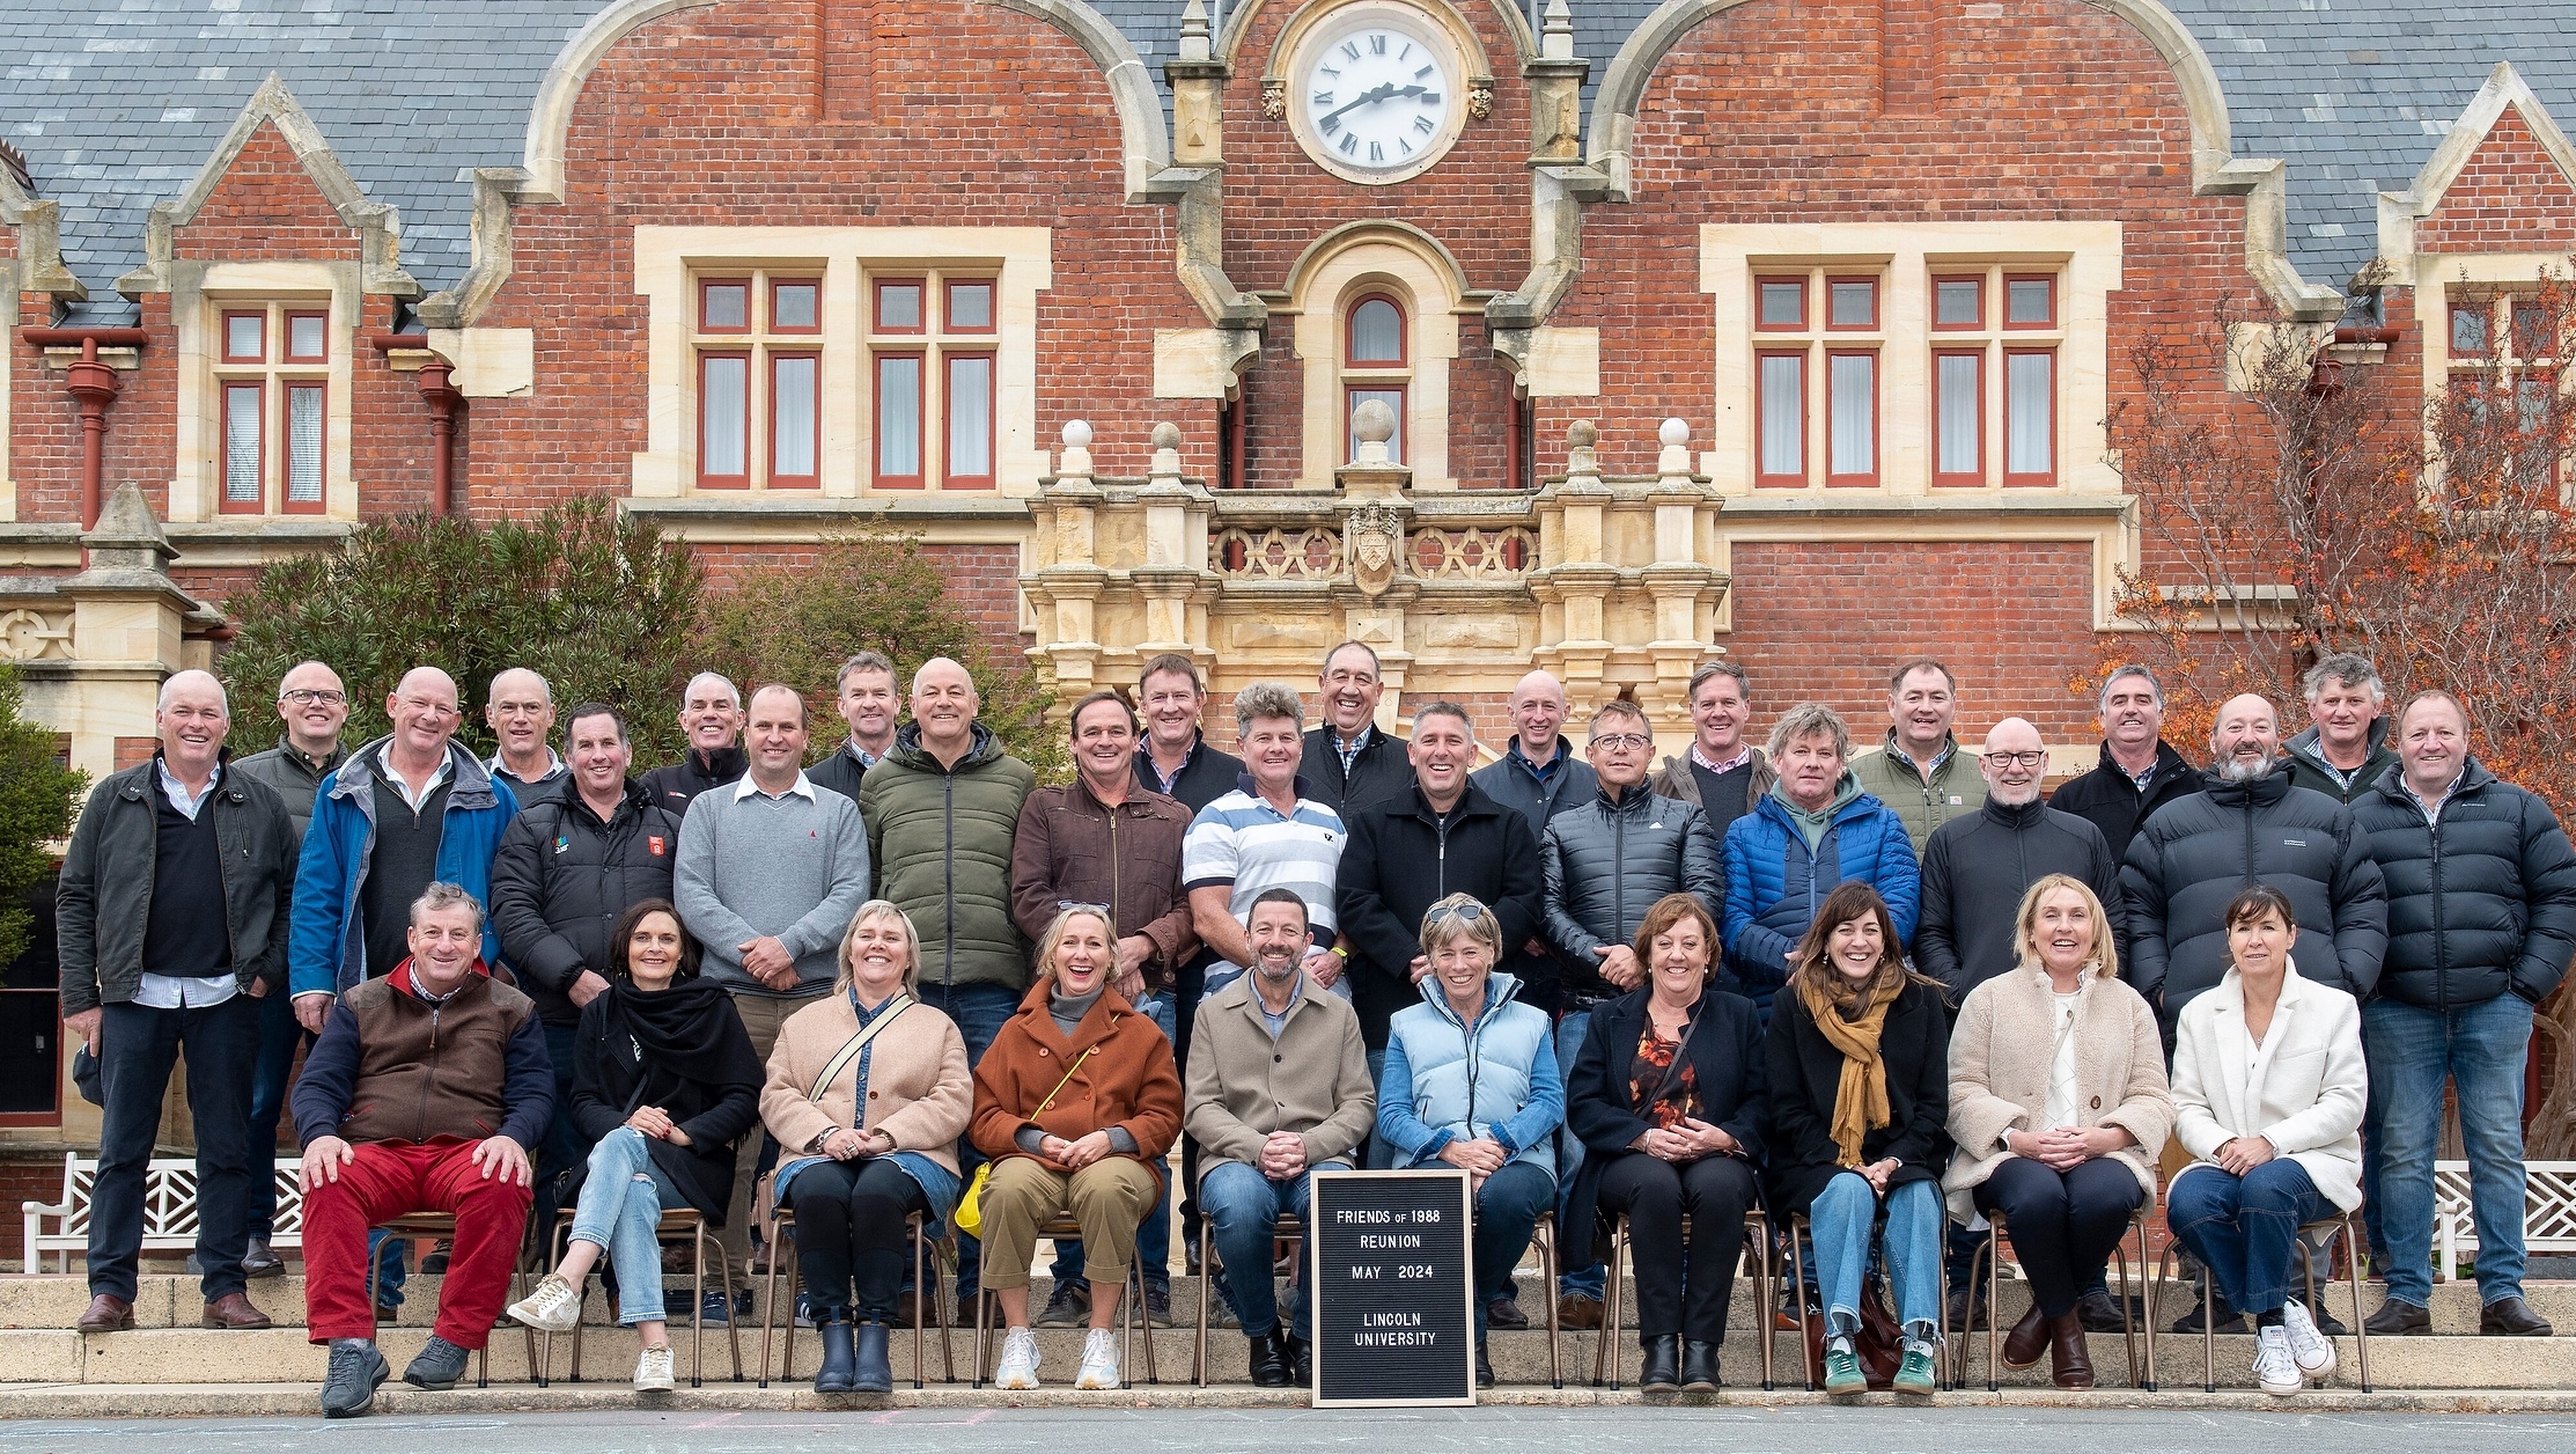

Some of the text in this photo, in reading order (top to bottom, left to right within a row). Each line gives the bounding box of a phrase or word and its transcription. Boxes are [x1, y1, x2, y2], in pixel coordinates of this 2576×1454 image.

[1321, 63, 1341, 79] X
[1337, 1209, 1440, 1224] FRIENDS OF 1988
[1360, 1235, 1420, 1248] REUNION
[1352, 1265, 1433, 1279] MAY 2024
[1364, 1312, 1421, 1326] LINCOLN
[1355, 1332, 1436, 1346] UNIVERSITY
